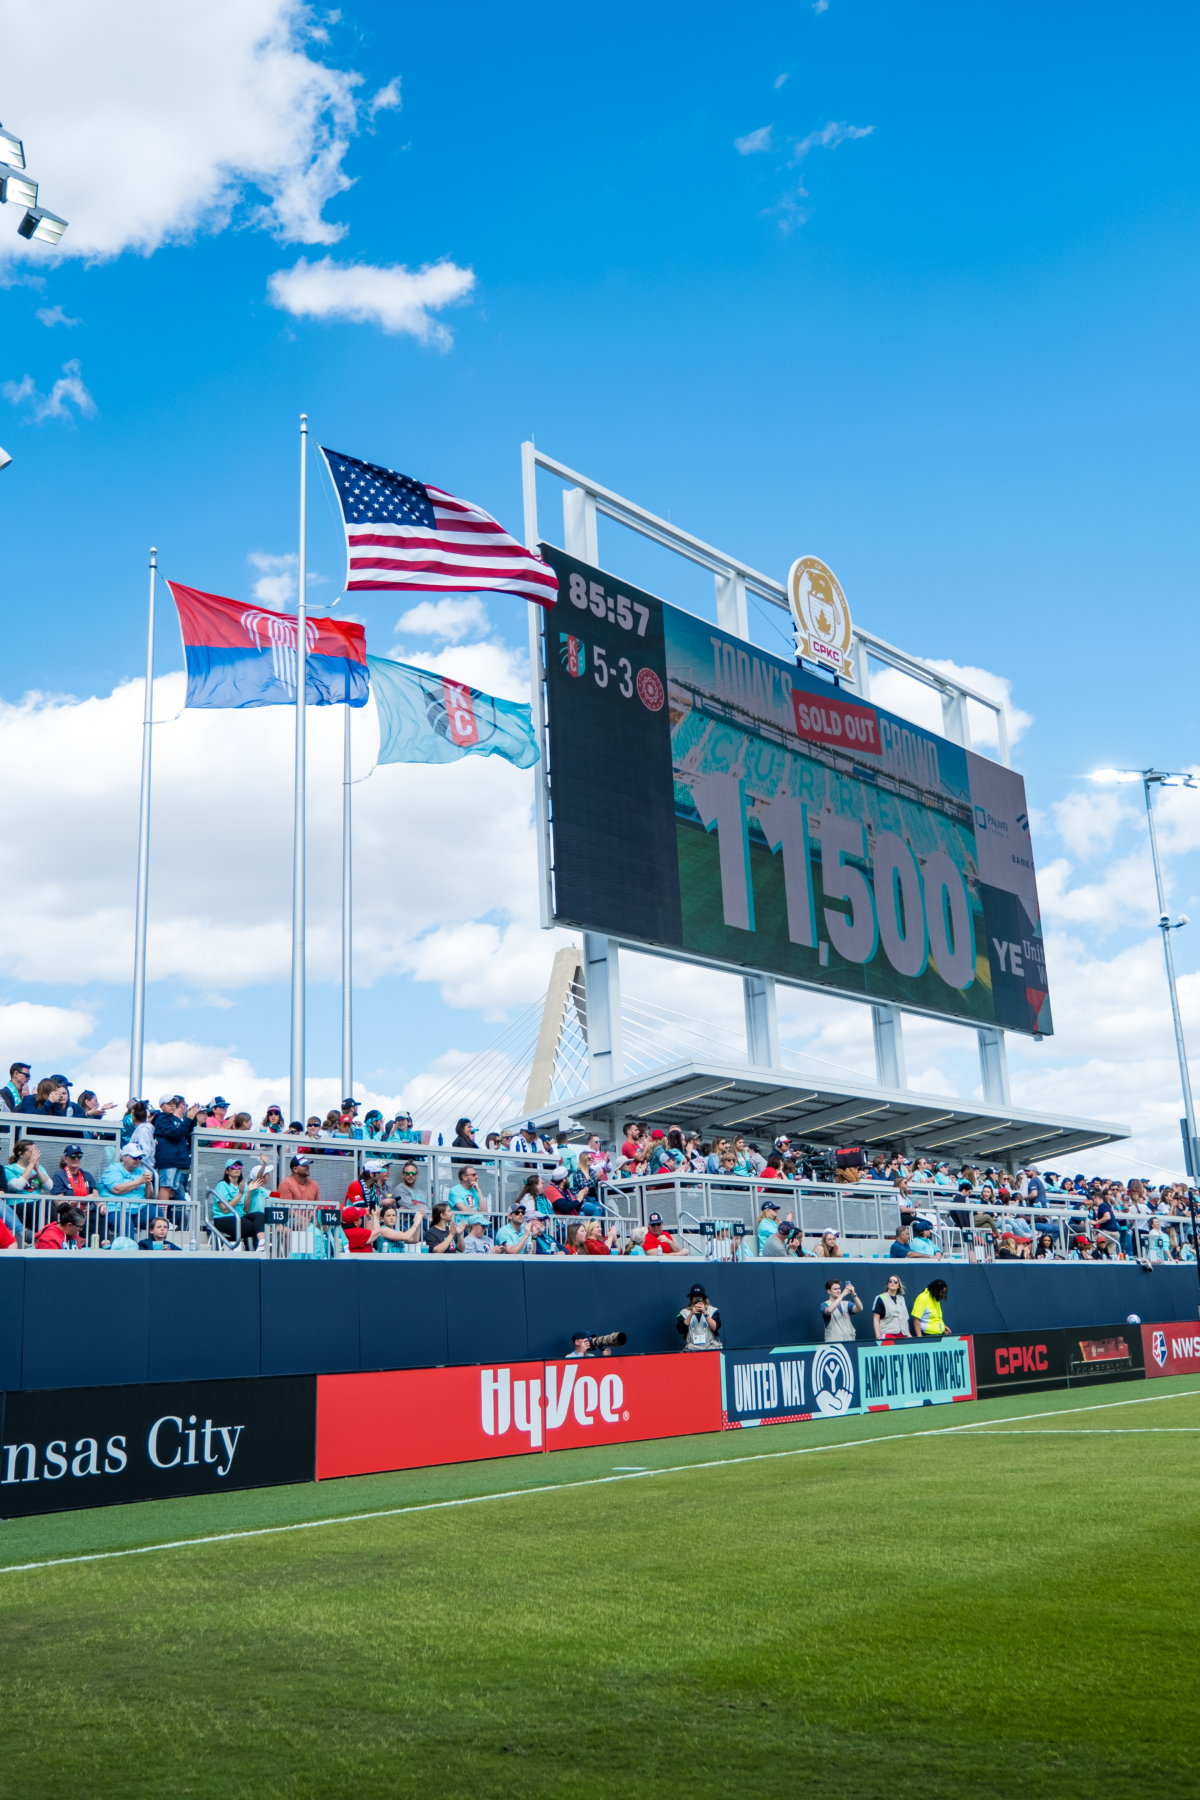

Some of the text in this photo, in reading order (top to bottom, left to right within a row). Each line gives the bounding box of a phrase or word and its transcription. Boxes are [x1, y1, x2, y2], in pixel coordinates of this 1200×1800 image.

[569, 572, 650, 637] 85:57
[593, 645, 634, 698] 5-3
[813, 640, 840, 662] CPKC
[710, 636, 795, 717] TODAY'S
[798, 702, 875, 744] SOLD OUT
[879, 717, 942, 792] CROWD
[691, 774, 976, 989] 11,500
[1011, 854, 1030, 869] BANK
[991, 937, 1025, 977] YE
[836, 1147, 860, 1155] ESPN
[272, 1210, 285, 1221] 113
[325, 1212, 338, 1222] 114
[865, 1349, 968, 1399] AMPLIFY YOUR IMPACT
[995, 1344, 1048, 1375] CPKC
[733, 1360, 806, 1413] UNITED WAY
[0, 1414, 245, 1484] nsas City
